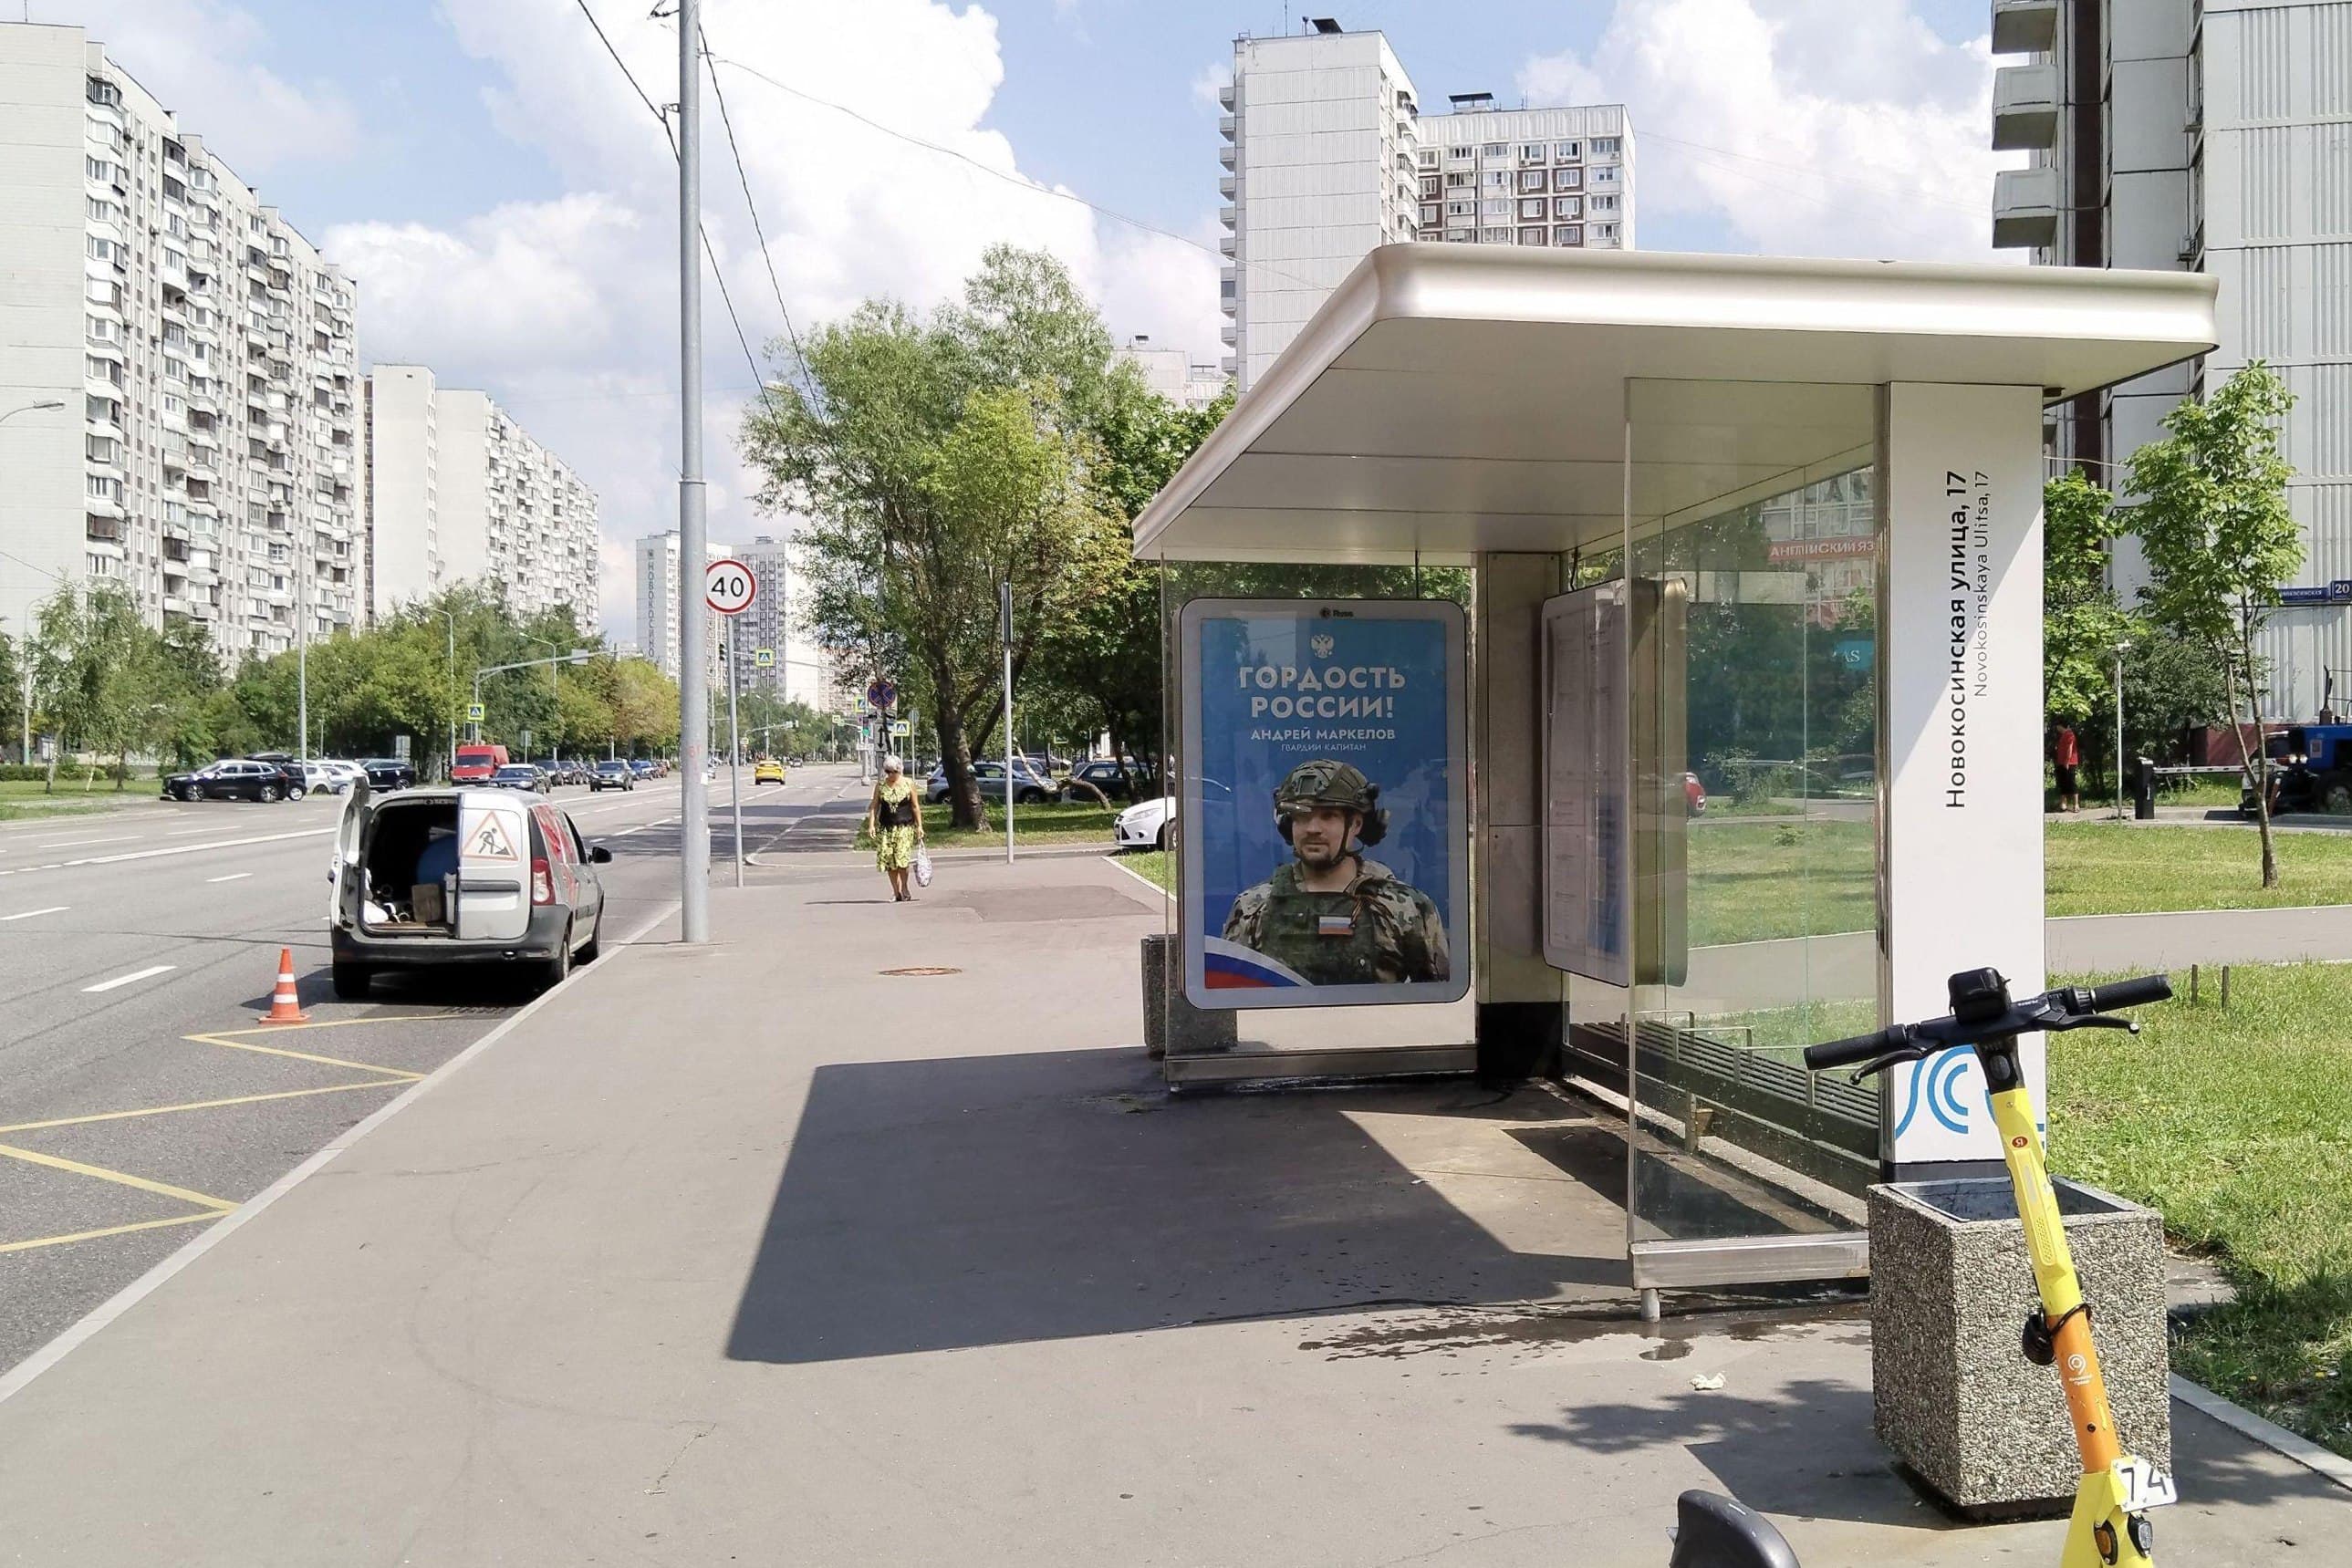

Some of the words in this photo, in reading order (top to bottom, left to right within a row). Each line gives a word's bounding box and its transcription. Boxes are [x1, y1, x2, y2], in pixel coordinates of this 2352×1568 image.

[1946, 470, 1966, 497] 17
[1974, 471, 1989, 488] 17
[1973, 493, 1991, 548] Ulitsa,
[1950, 504, 1971, 592] улица,
[711, 576, 744, 597] 40
[2335, 583, 2350, 594] 20
[1973, 554, 1990, 697] Novokosinskaya
[1239, 666, 1406, 691] ГОРДОСТЬ
[1251, 696, 1394, 719] РОССИИ!
[1945, 598, 1966, 808] Новокосинская
[1251, 726, 1311, 742] АНДРЕЙ
[1316, 729, 1396, 741] МАРКЕЛОВ
[1281, 743, 1322, 753] ГВАРДИИ
[1325, 743, 1367, 752] КАПИТАН
